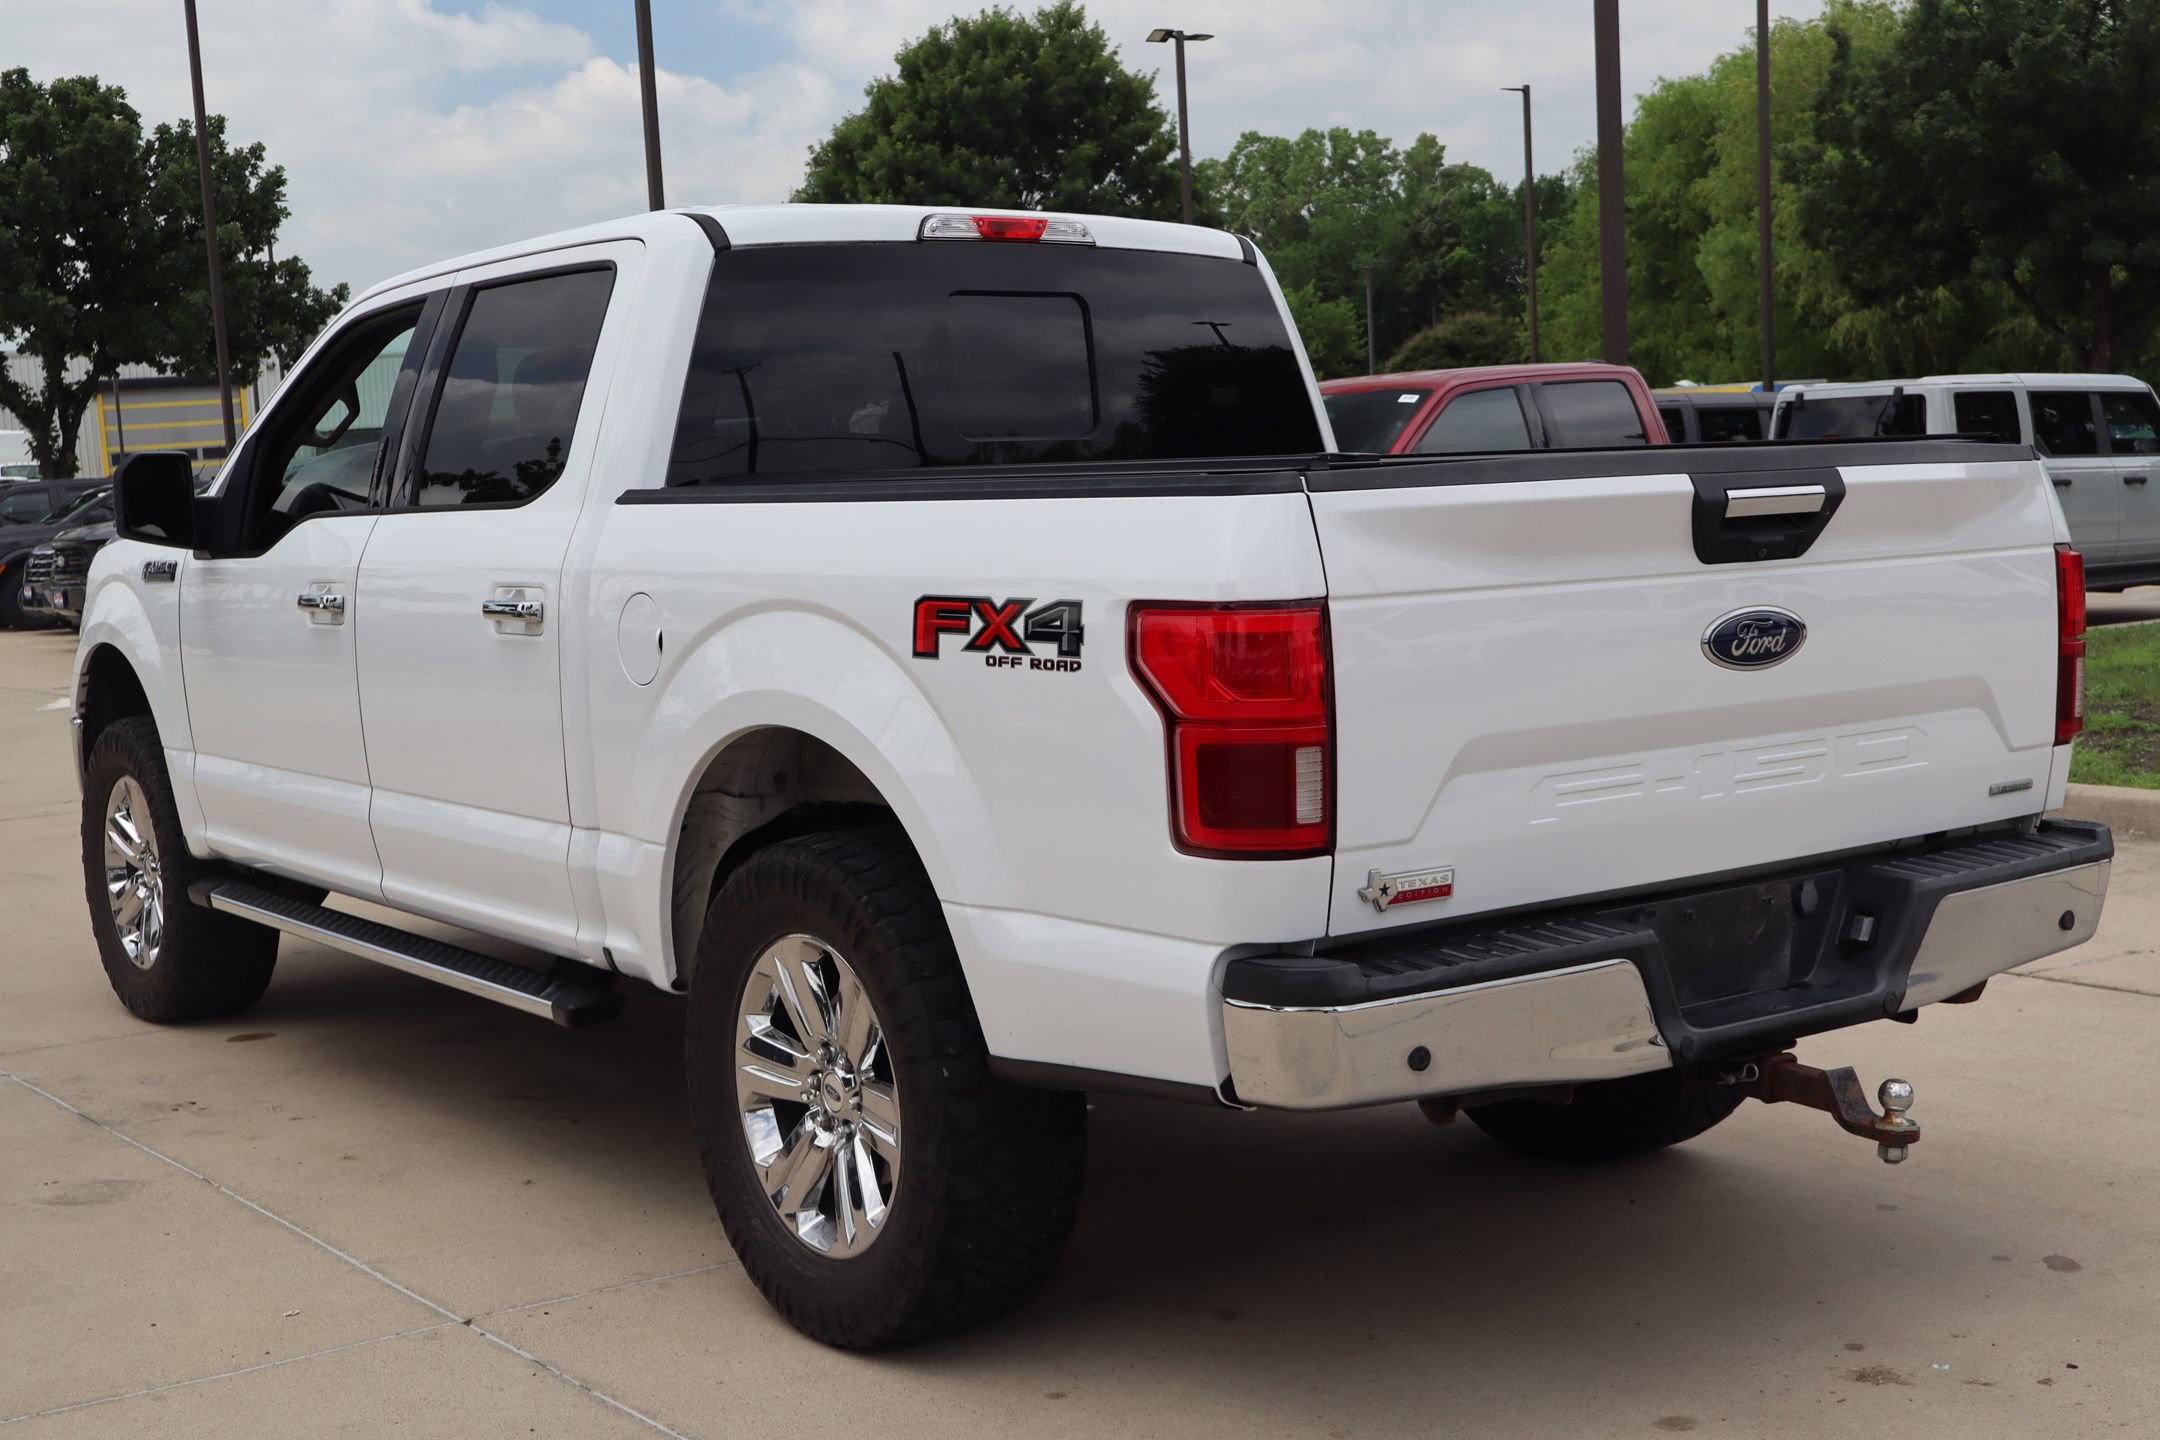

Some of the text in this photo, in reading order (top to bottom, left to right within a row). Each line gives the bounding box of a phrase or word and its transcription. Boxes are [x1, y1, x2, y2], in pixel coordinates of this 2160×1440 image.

[912, 594, 1084, 660] FX4
[1731, 620, 1787, 656] Ford
[985, 655, 1082, 672] OFF ROAD
[1398, 873, 1450, 889] TEXAS
[1398, 886, 1449, 899] EDITION
